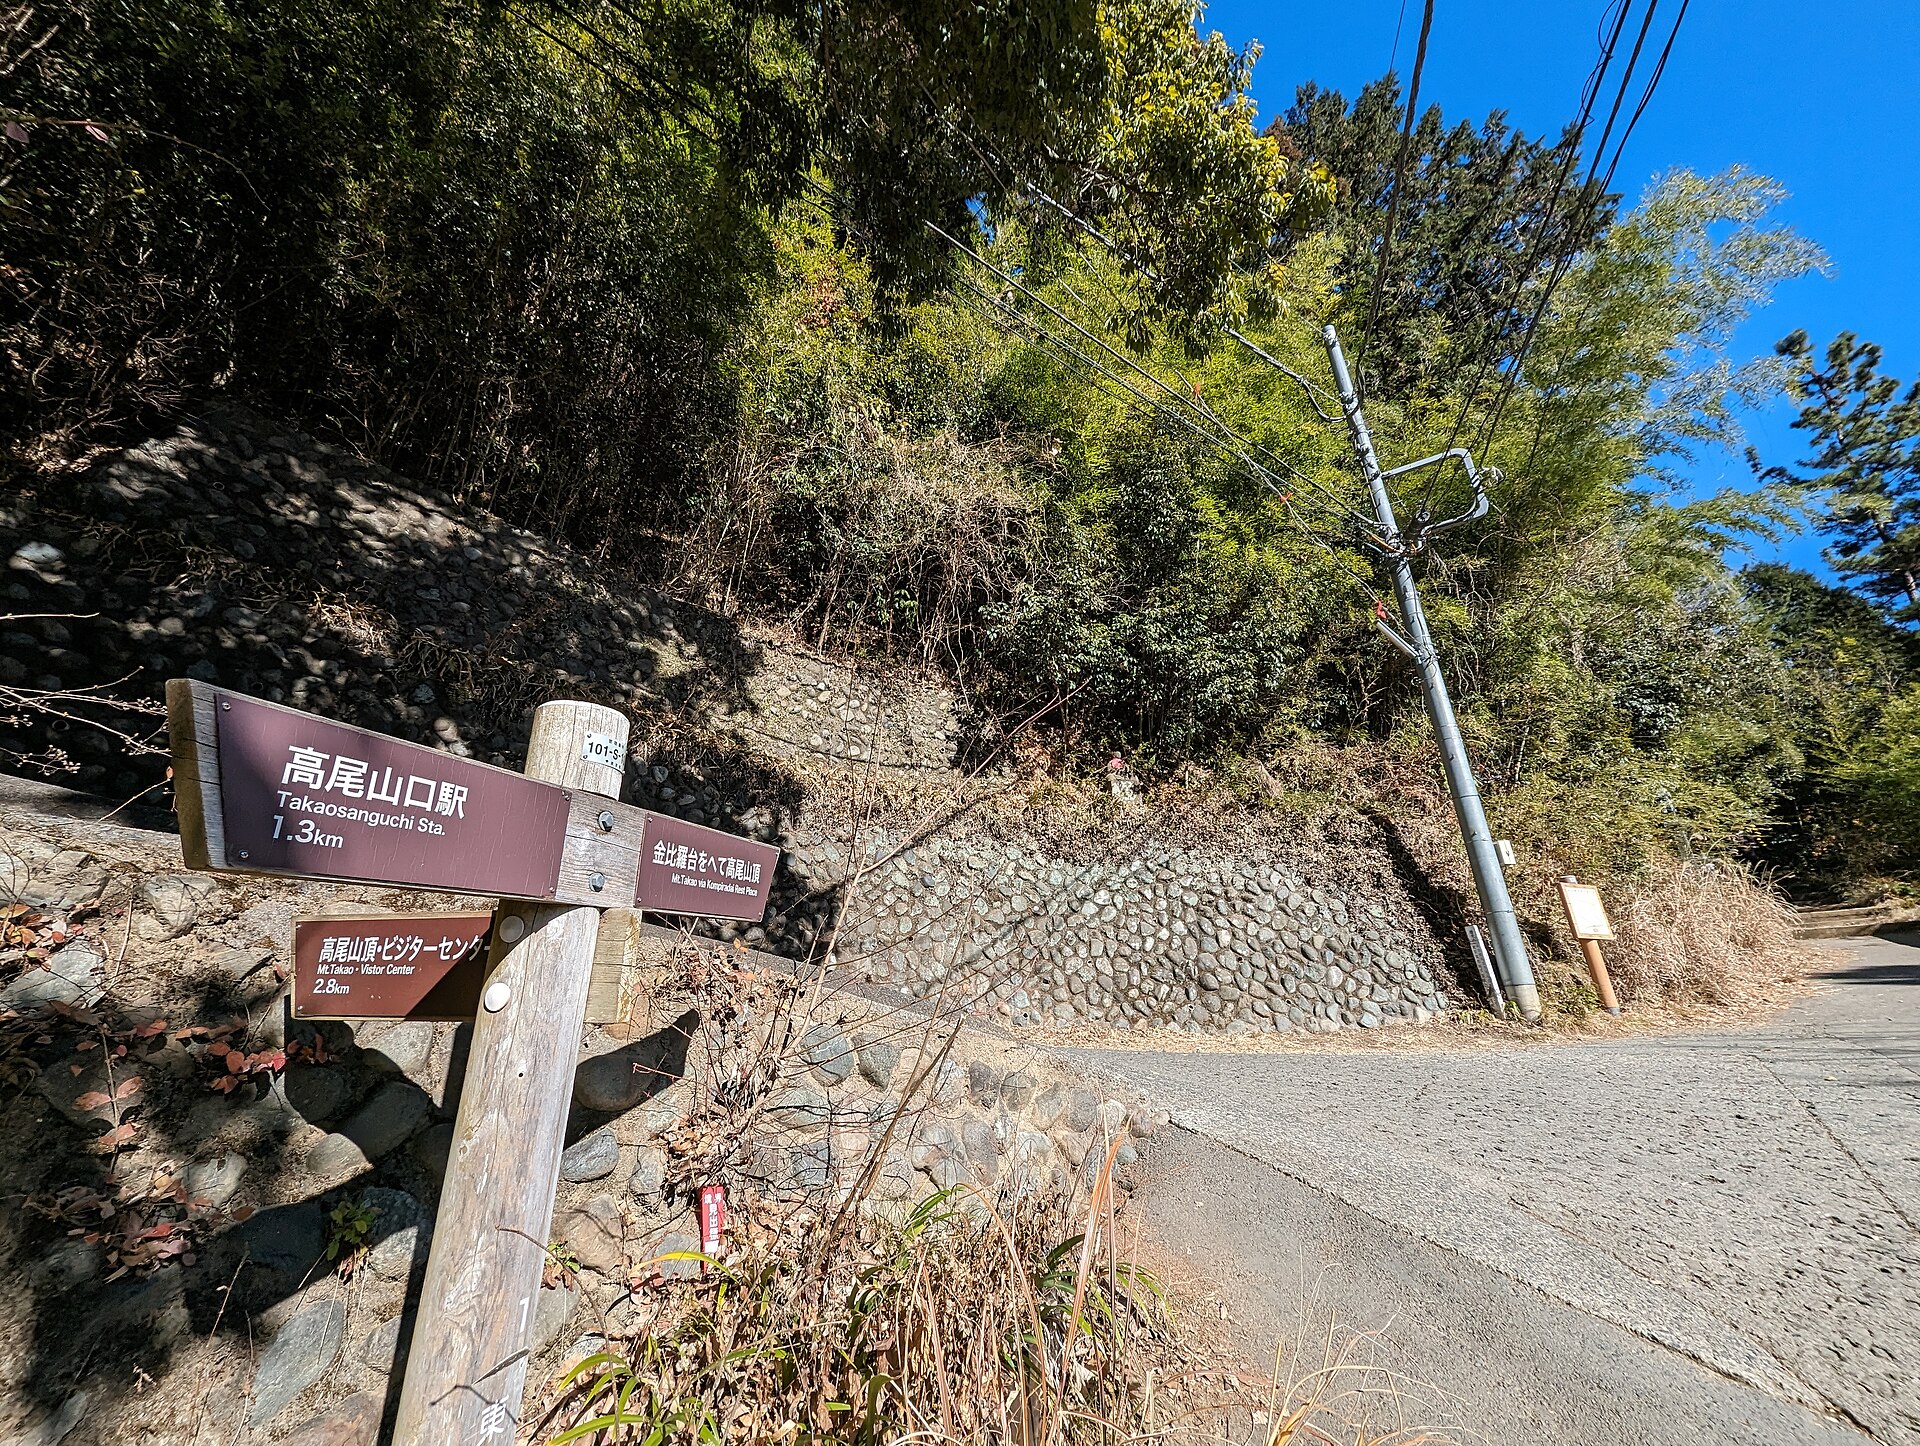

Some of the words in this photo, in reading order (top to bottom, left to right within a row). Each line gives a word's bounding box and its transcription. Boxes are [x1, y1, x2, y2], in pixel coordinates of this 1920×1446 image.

[280, 745, 469, 819] 高尾山口駅
[276, 790, 414, 830] Takaosanguchi
[417, 818, 446, 836] Sta.
[272, 814, 344, 849] 1.3km
[652, 840, 761, 884] 金比羅台をへて高尾山頂
[698, 878, 707, 888] via
[312, 978, 350, 994] 2.8km
[360, 963, 385, 975] Vistor
[386, 963, 416, 975] Center
